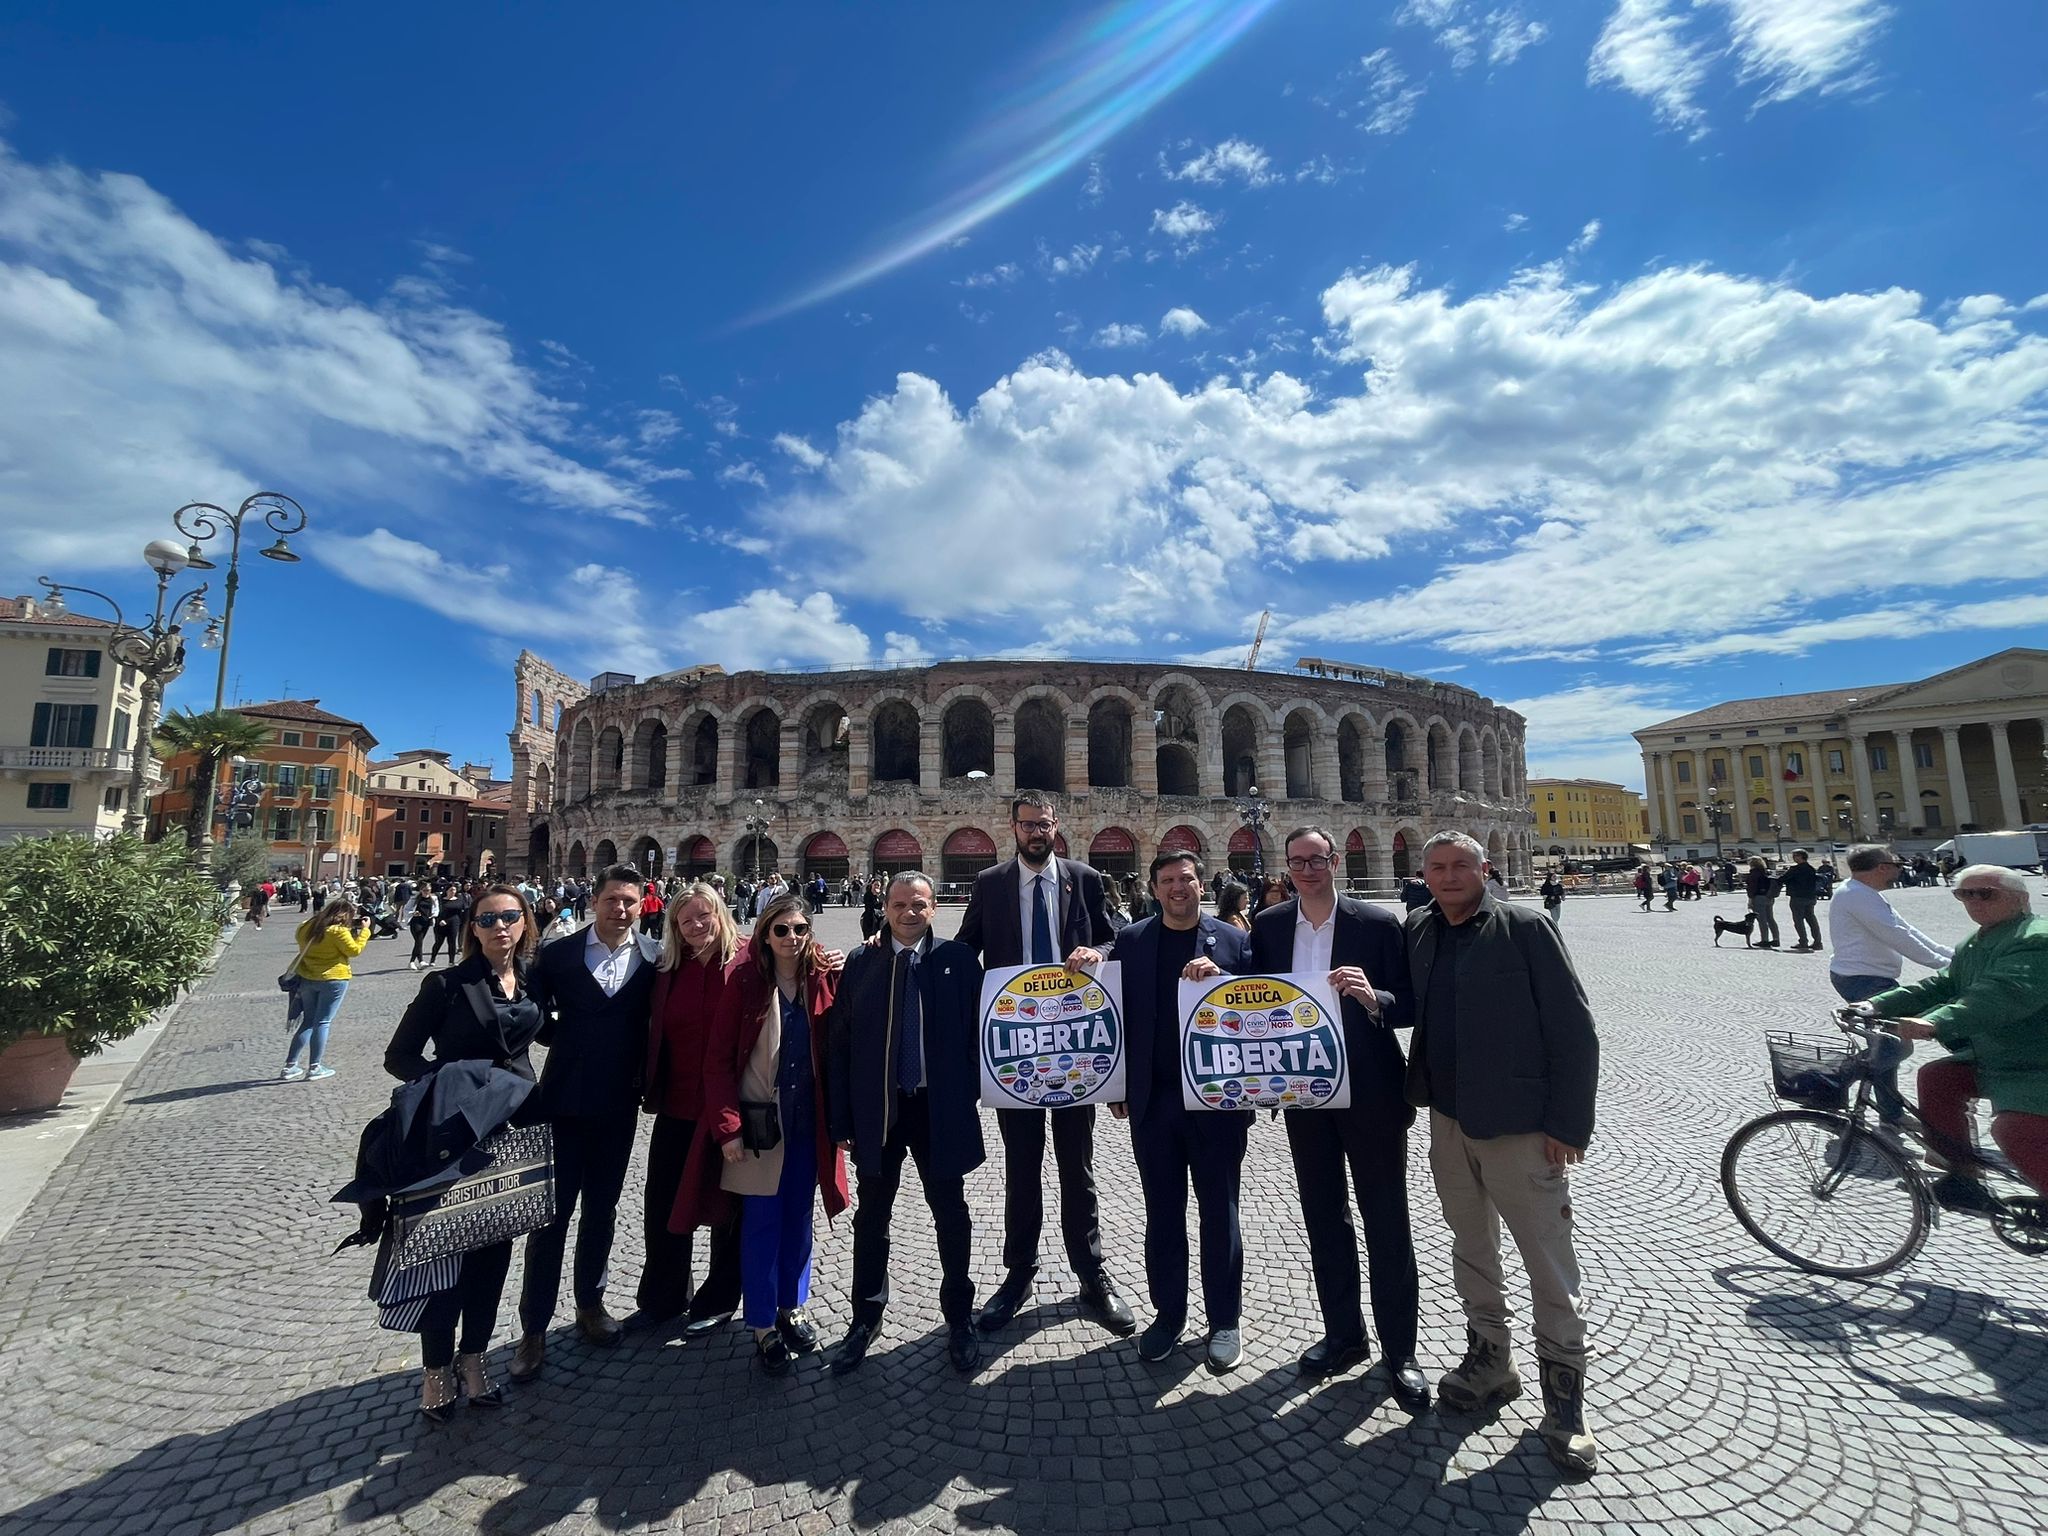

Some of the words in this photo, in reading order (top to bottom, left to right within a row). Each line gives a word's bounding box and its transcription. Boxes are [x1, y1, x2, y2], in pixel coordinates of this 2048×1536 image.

[1032, 971, 1063, 981] CATENO
[1024, 982, 1039, 993] DE
[1042, 978, 1074, 991] LUCA
[1233, 983, 1268, 992] CATENO
[1225, 992, 1243, 1005] DE
[1245, 990, 1283, 1004] LUCA
[1063, 1004, 1082, 1013] NORD
[1271, 1021, 1293, 1029] NORD
[992, 1015, 1112, 1058] LIBERTÀ
[1193, 1033, 1332, 1075] LIBERTÀ
[1044, 1095, 1071, 1103] ITALEXIT
[440, 1180, 494, 1207] CHRISTIAN
[498, 1174, 520, 1192] DIOR
